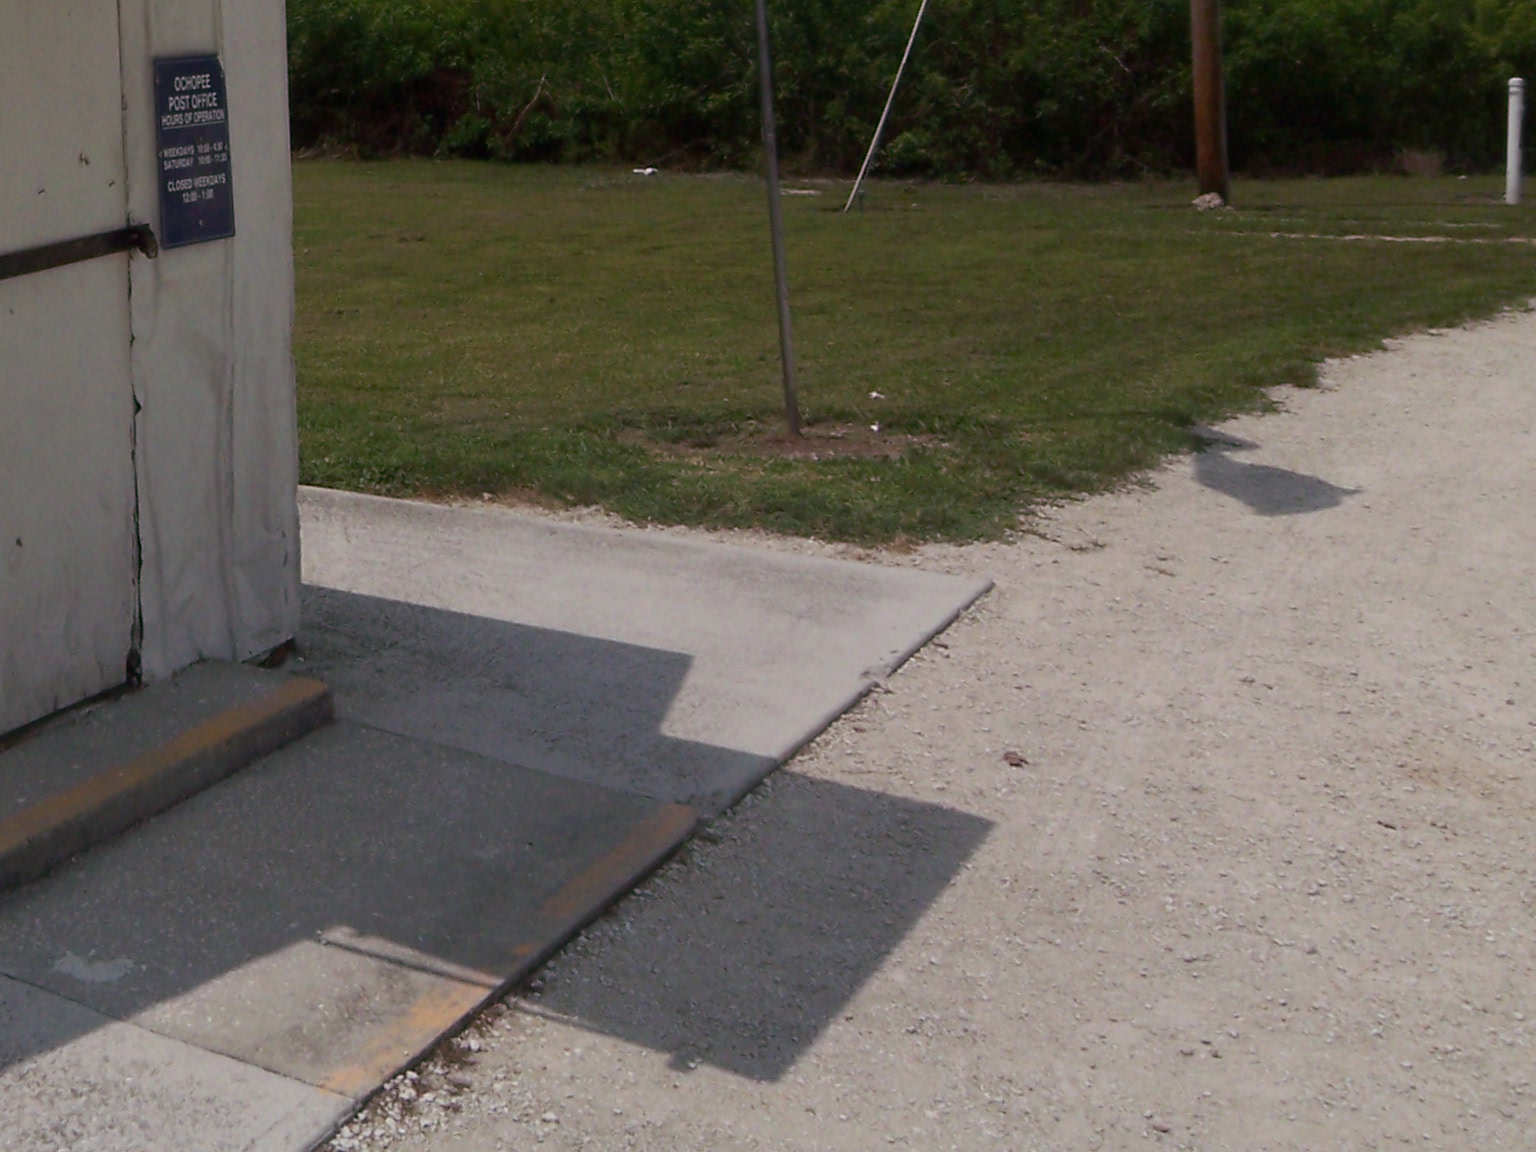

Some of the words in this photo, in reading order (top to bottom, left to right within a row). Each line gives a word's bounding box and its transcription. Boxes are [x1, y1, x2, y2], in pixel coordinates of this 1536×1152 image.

[174, 74, 211, 92] OCHOPEE
[168, 95, 190, 112] POST
[191, 92, 218, 109] OFFICE
[161, 113, 184, 127] HOURS
[184, 112, 193, 124] OF
[193, 109, 225, 123] OPERATION
[163, 145, 194, 158] WEEKDAYS
[163, 157, 194, 171] SATURDAY
[167, 178, 193, 192] CLOSED
[193, 172, 226, 188] WEEKDAYS
